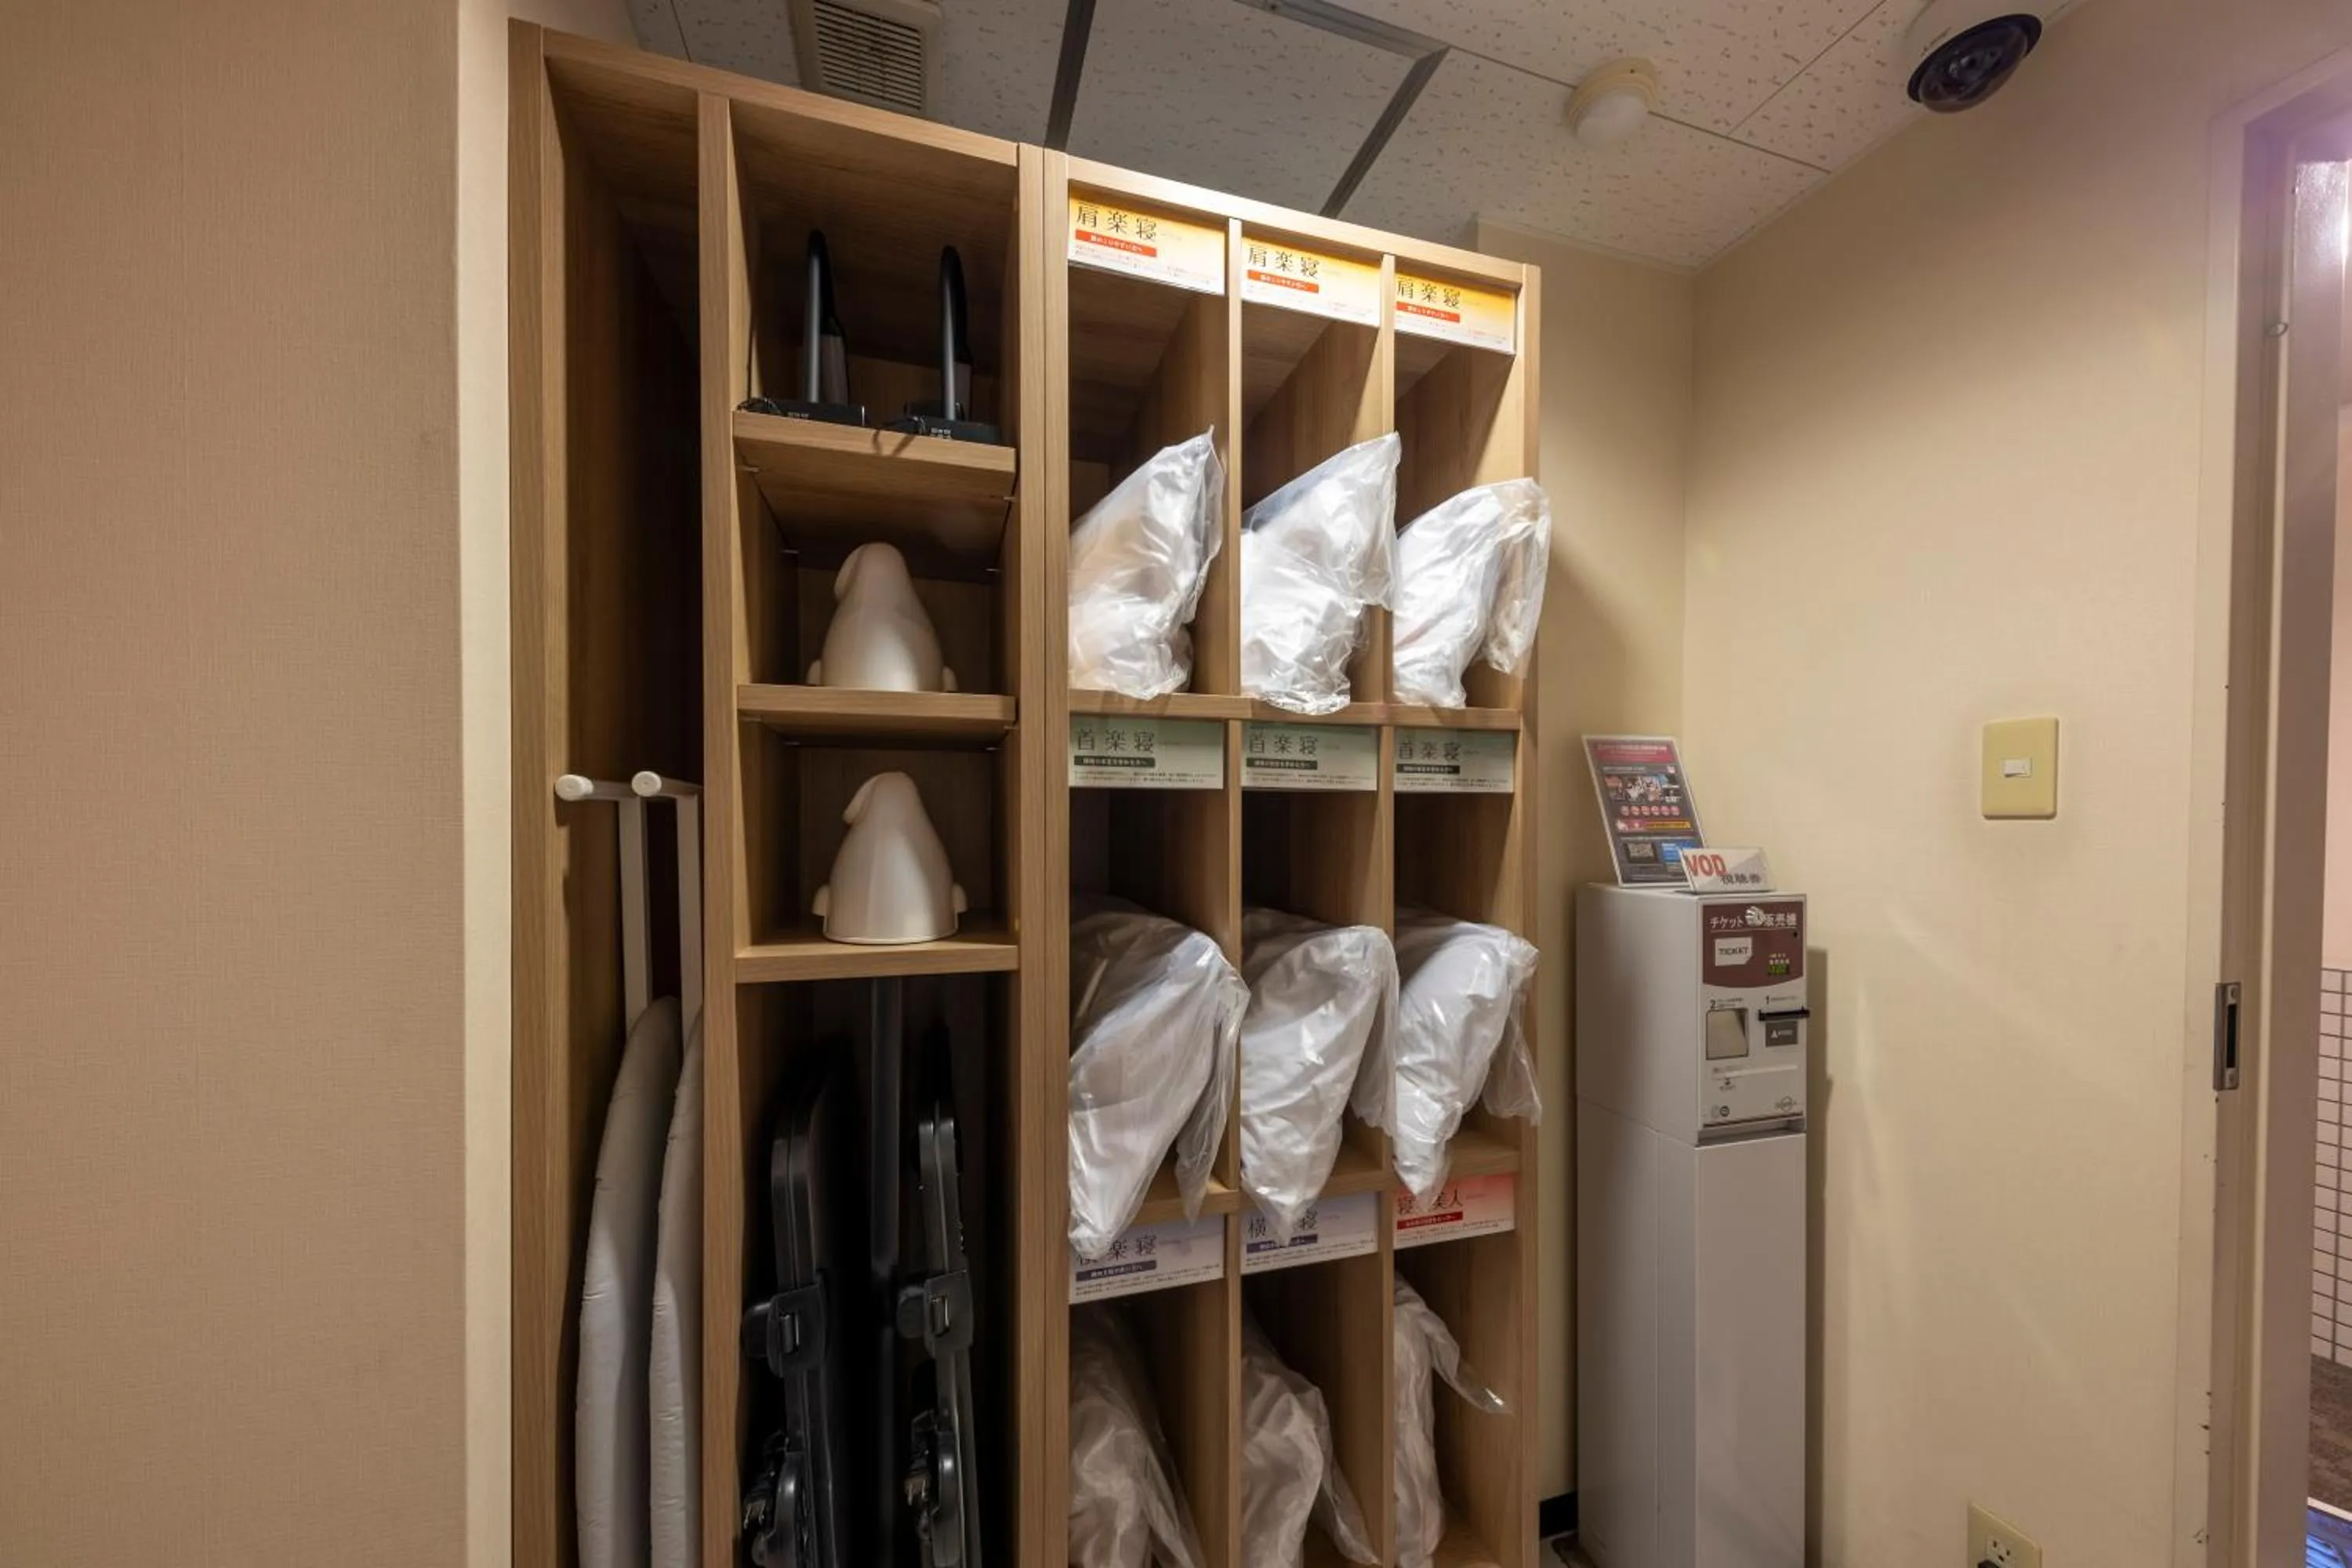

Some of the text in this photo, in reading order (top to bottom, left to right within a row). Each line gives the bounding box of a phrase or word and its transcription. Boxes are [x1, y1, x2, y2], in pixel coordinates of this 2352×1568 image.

[1076, 201, 1156, 241] 肩楽寝
[1248, 245, 1319, 279] 肩楽寝
[1077, 728, 1155, 753] 首楽寝
[1682, 853, 1727, 877] VOD
[1710, 916, 1744, 929] チケット
[1718, 946, 1749, 956] TICKET
[1710, 1000, 1715, 1009] 2
